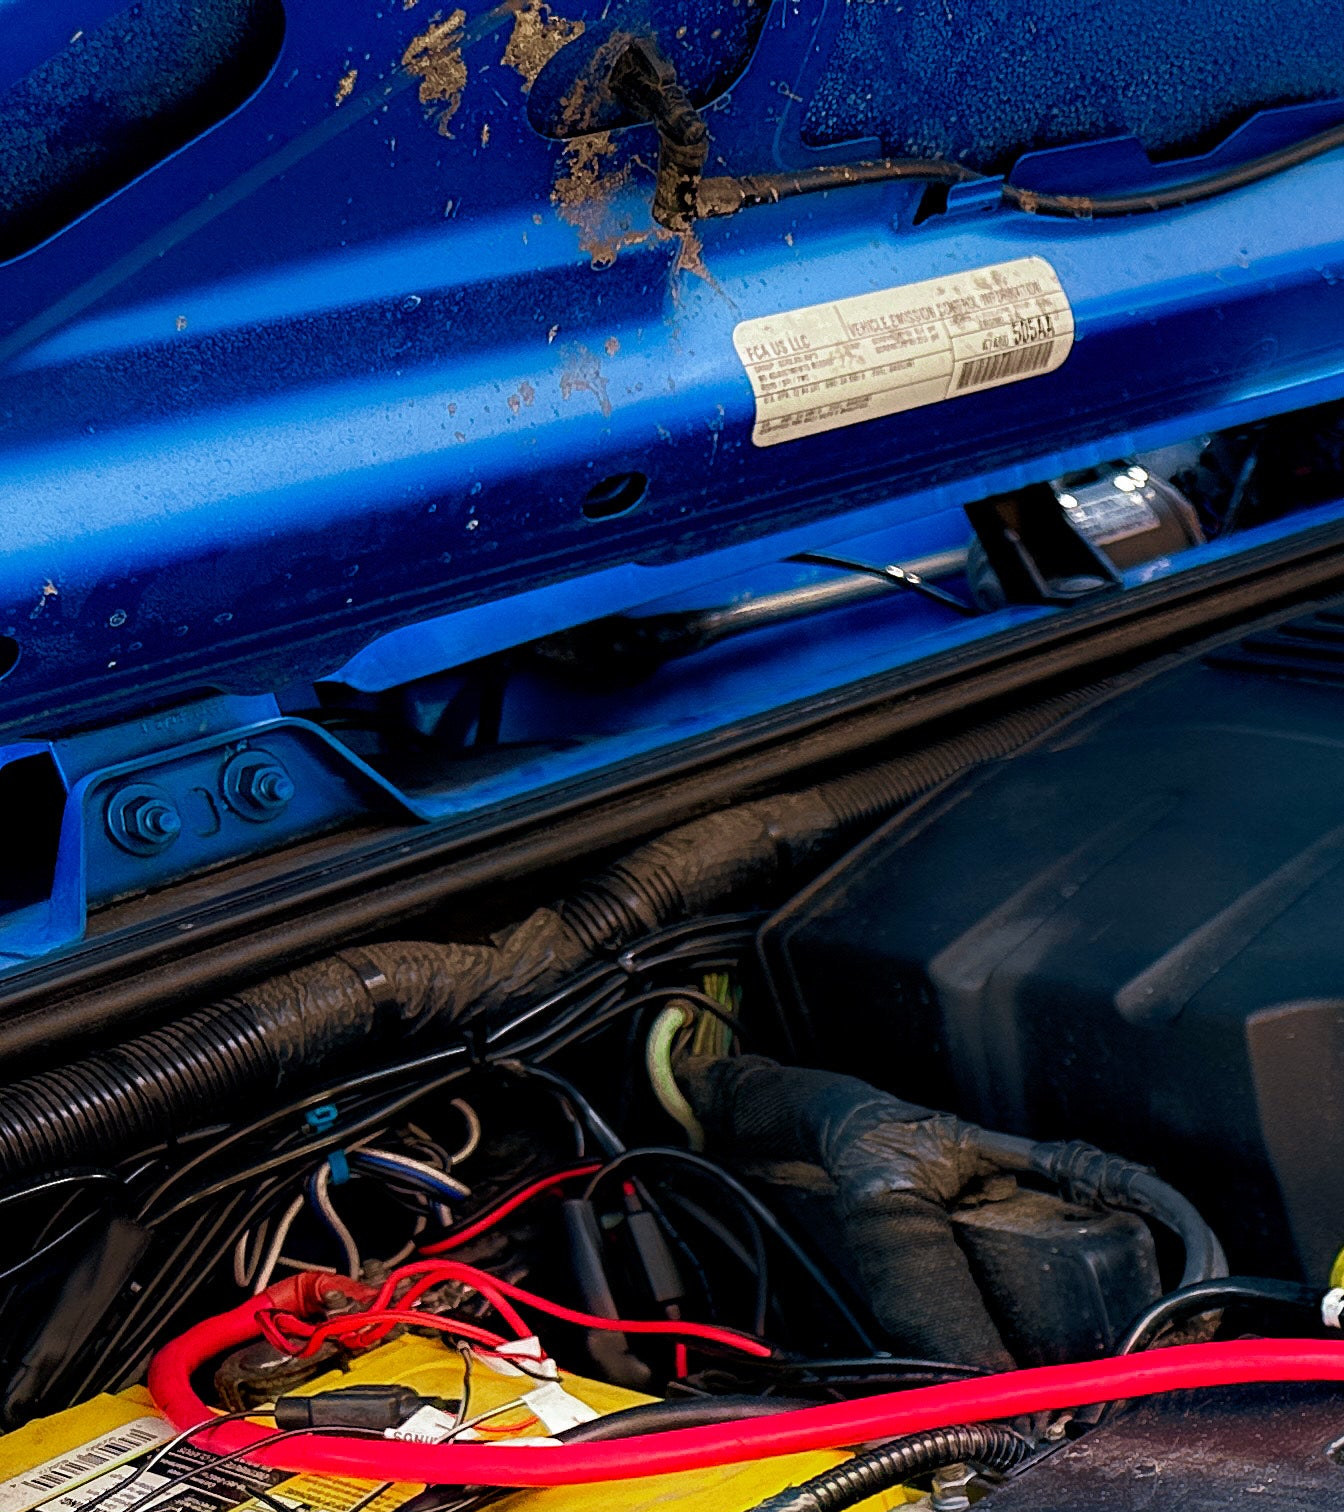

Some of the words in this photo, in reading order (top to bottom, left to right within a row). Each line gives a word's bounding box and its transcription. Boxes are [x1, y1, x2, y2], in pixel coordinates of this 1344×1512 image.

[746, 345, 771, 361] FCA
[772, 340, 788, 354] US
[790, 334, 811, 350] LLC
